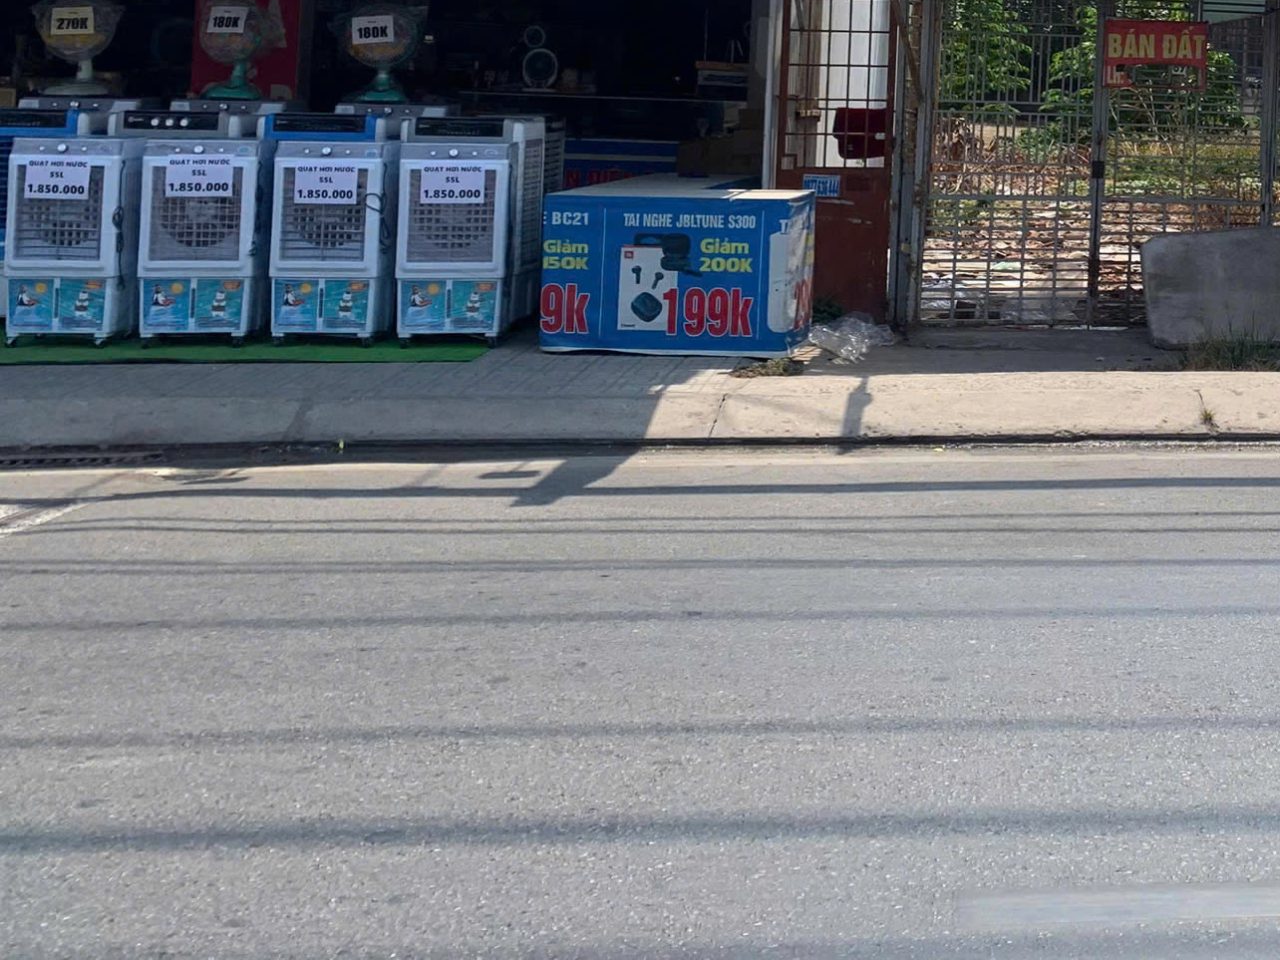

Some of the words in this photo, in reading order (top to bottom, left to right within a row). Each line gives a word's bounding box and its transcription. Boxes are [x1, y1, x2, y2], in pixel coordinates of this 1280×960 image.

[55, 16, 90, 31] 270K
[212, 15, 241, 29] 180K
[356, 25, 389, 40] 180K
[1107, 27, 1156, 59] BÁN
[1162, 25, 1207, 60] ĐẤT
[27, 183, 85, 194] 1.850.000
[168, 182, 229, 192] 1.850.000
[296, 189, 353, 200] 1.850.000
[423, 189, 481, 199] 1.850.000
[551, 210, 590, 226] BC21
[623, 212, 640, 228] TAI
[643, 213, 673, 228] NGHE
[728, 214, 757, 230] S300
[700, 237, 750, 255] Giảm
[699, 258, 753, 273] 200K
[662, 286, 754, 339] 199k
